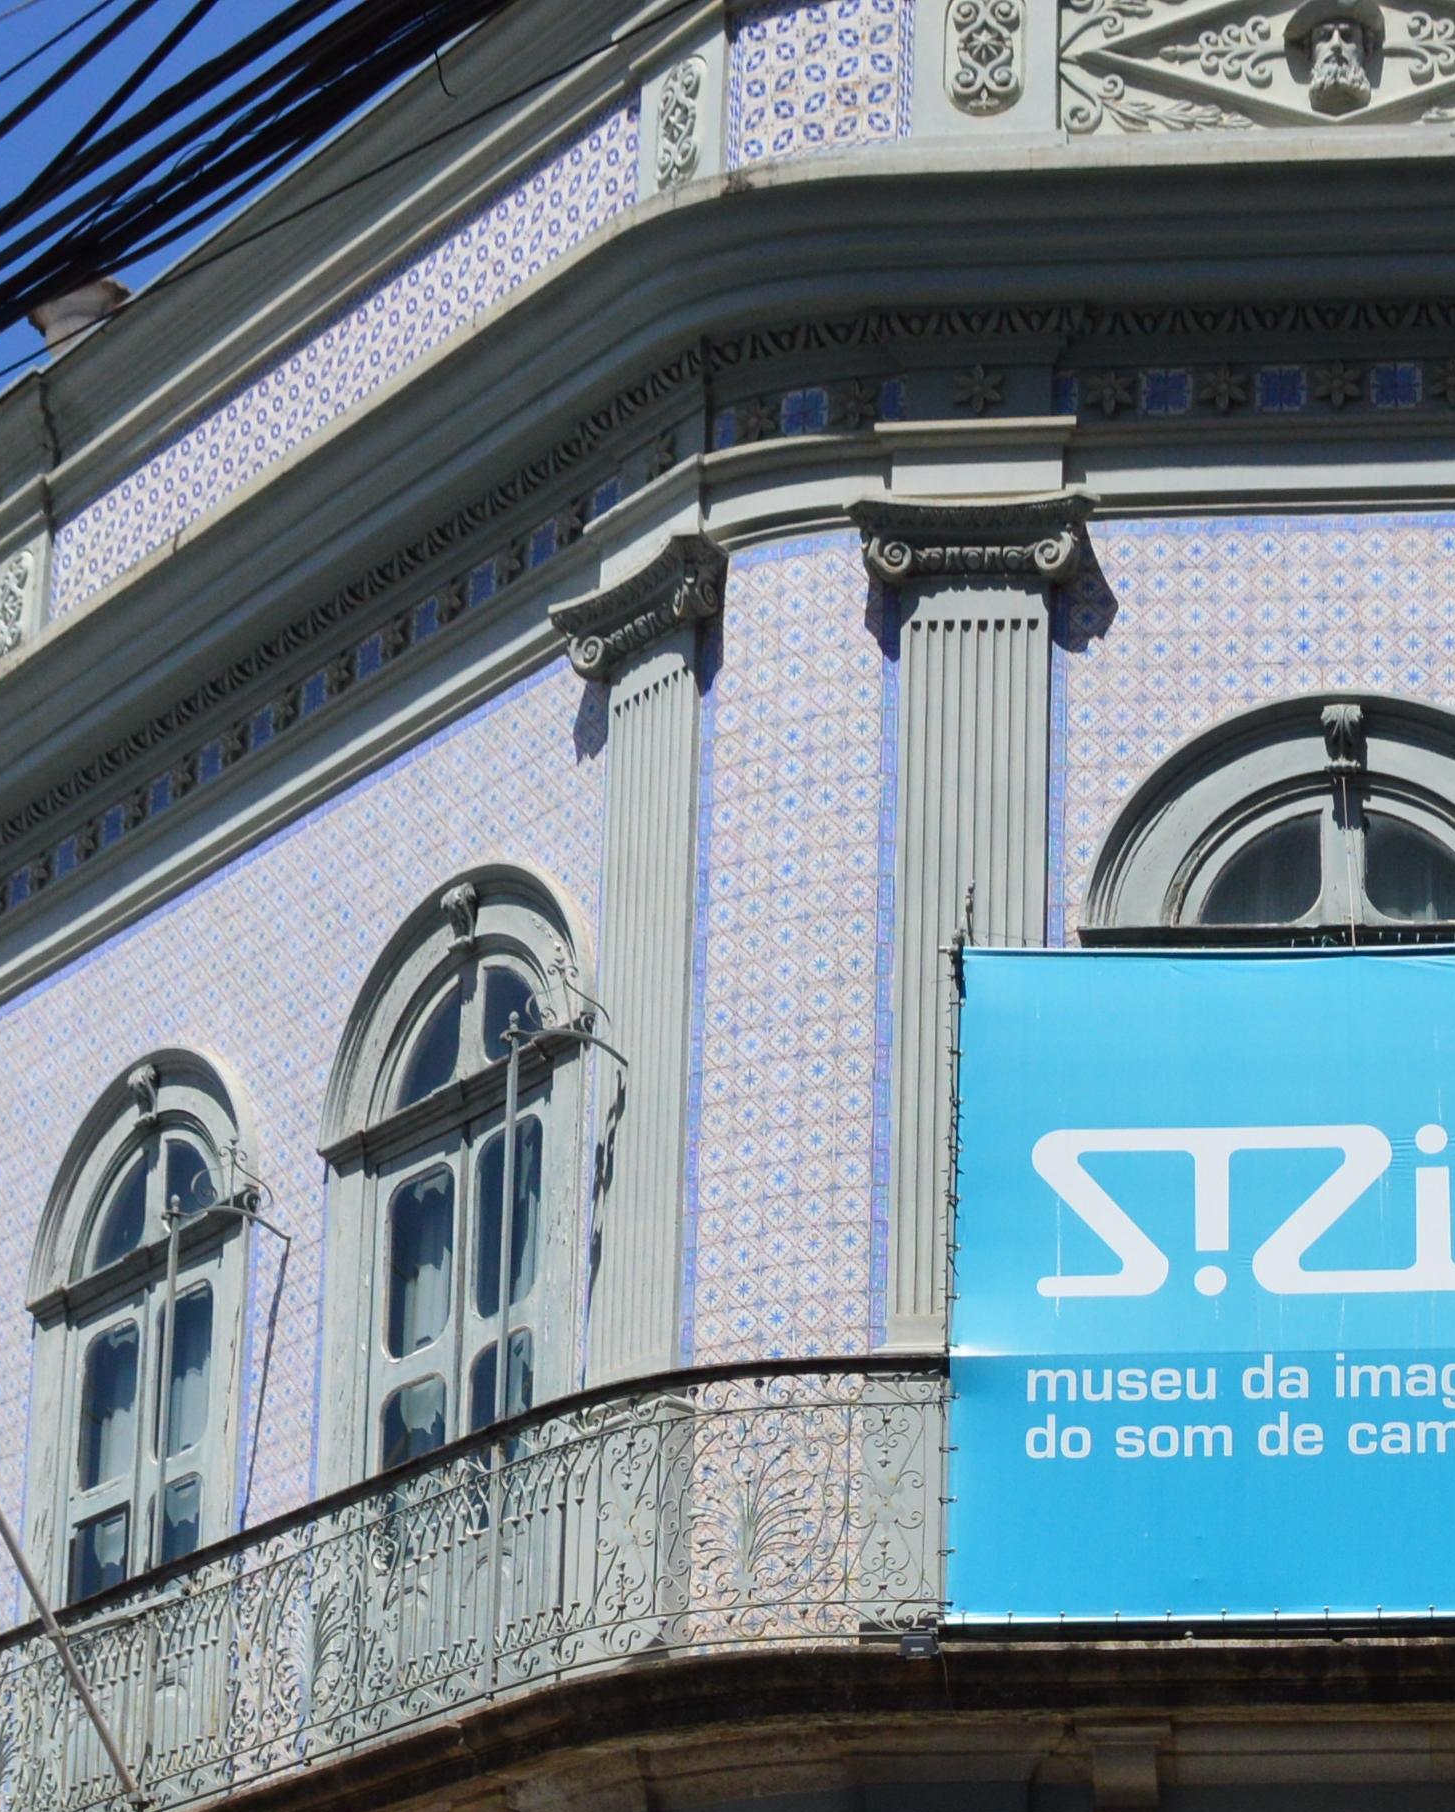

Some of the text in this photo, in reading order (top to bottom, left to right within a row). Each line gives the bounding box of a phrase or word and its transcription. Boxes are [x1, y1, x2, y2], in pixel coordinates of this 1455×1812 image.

[1027, 1368, 1216, 1402] museu
[1242, 1354, 1309, 1399] da
[1025, 1414, 1092, 1459] do
[1115, 1425, 1233, 1458] som
[1258, 1411, 1324, 1457] de
